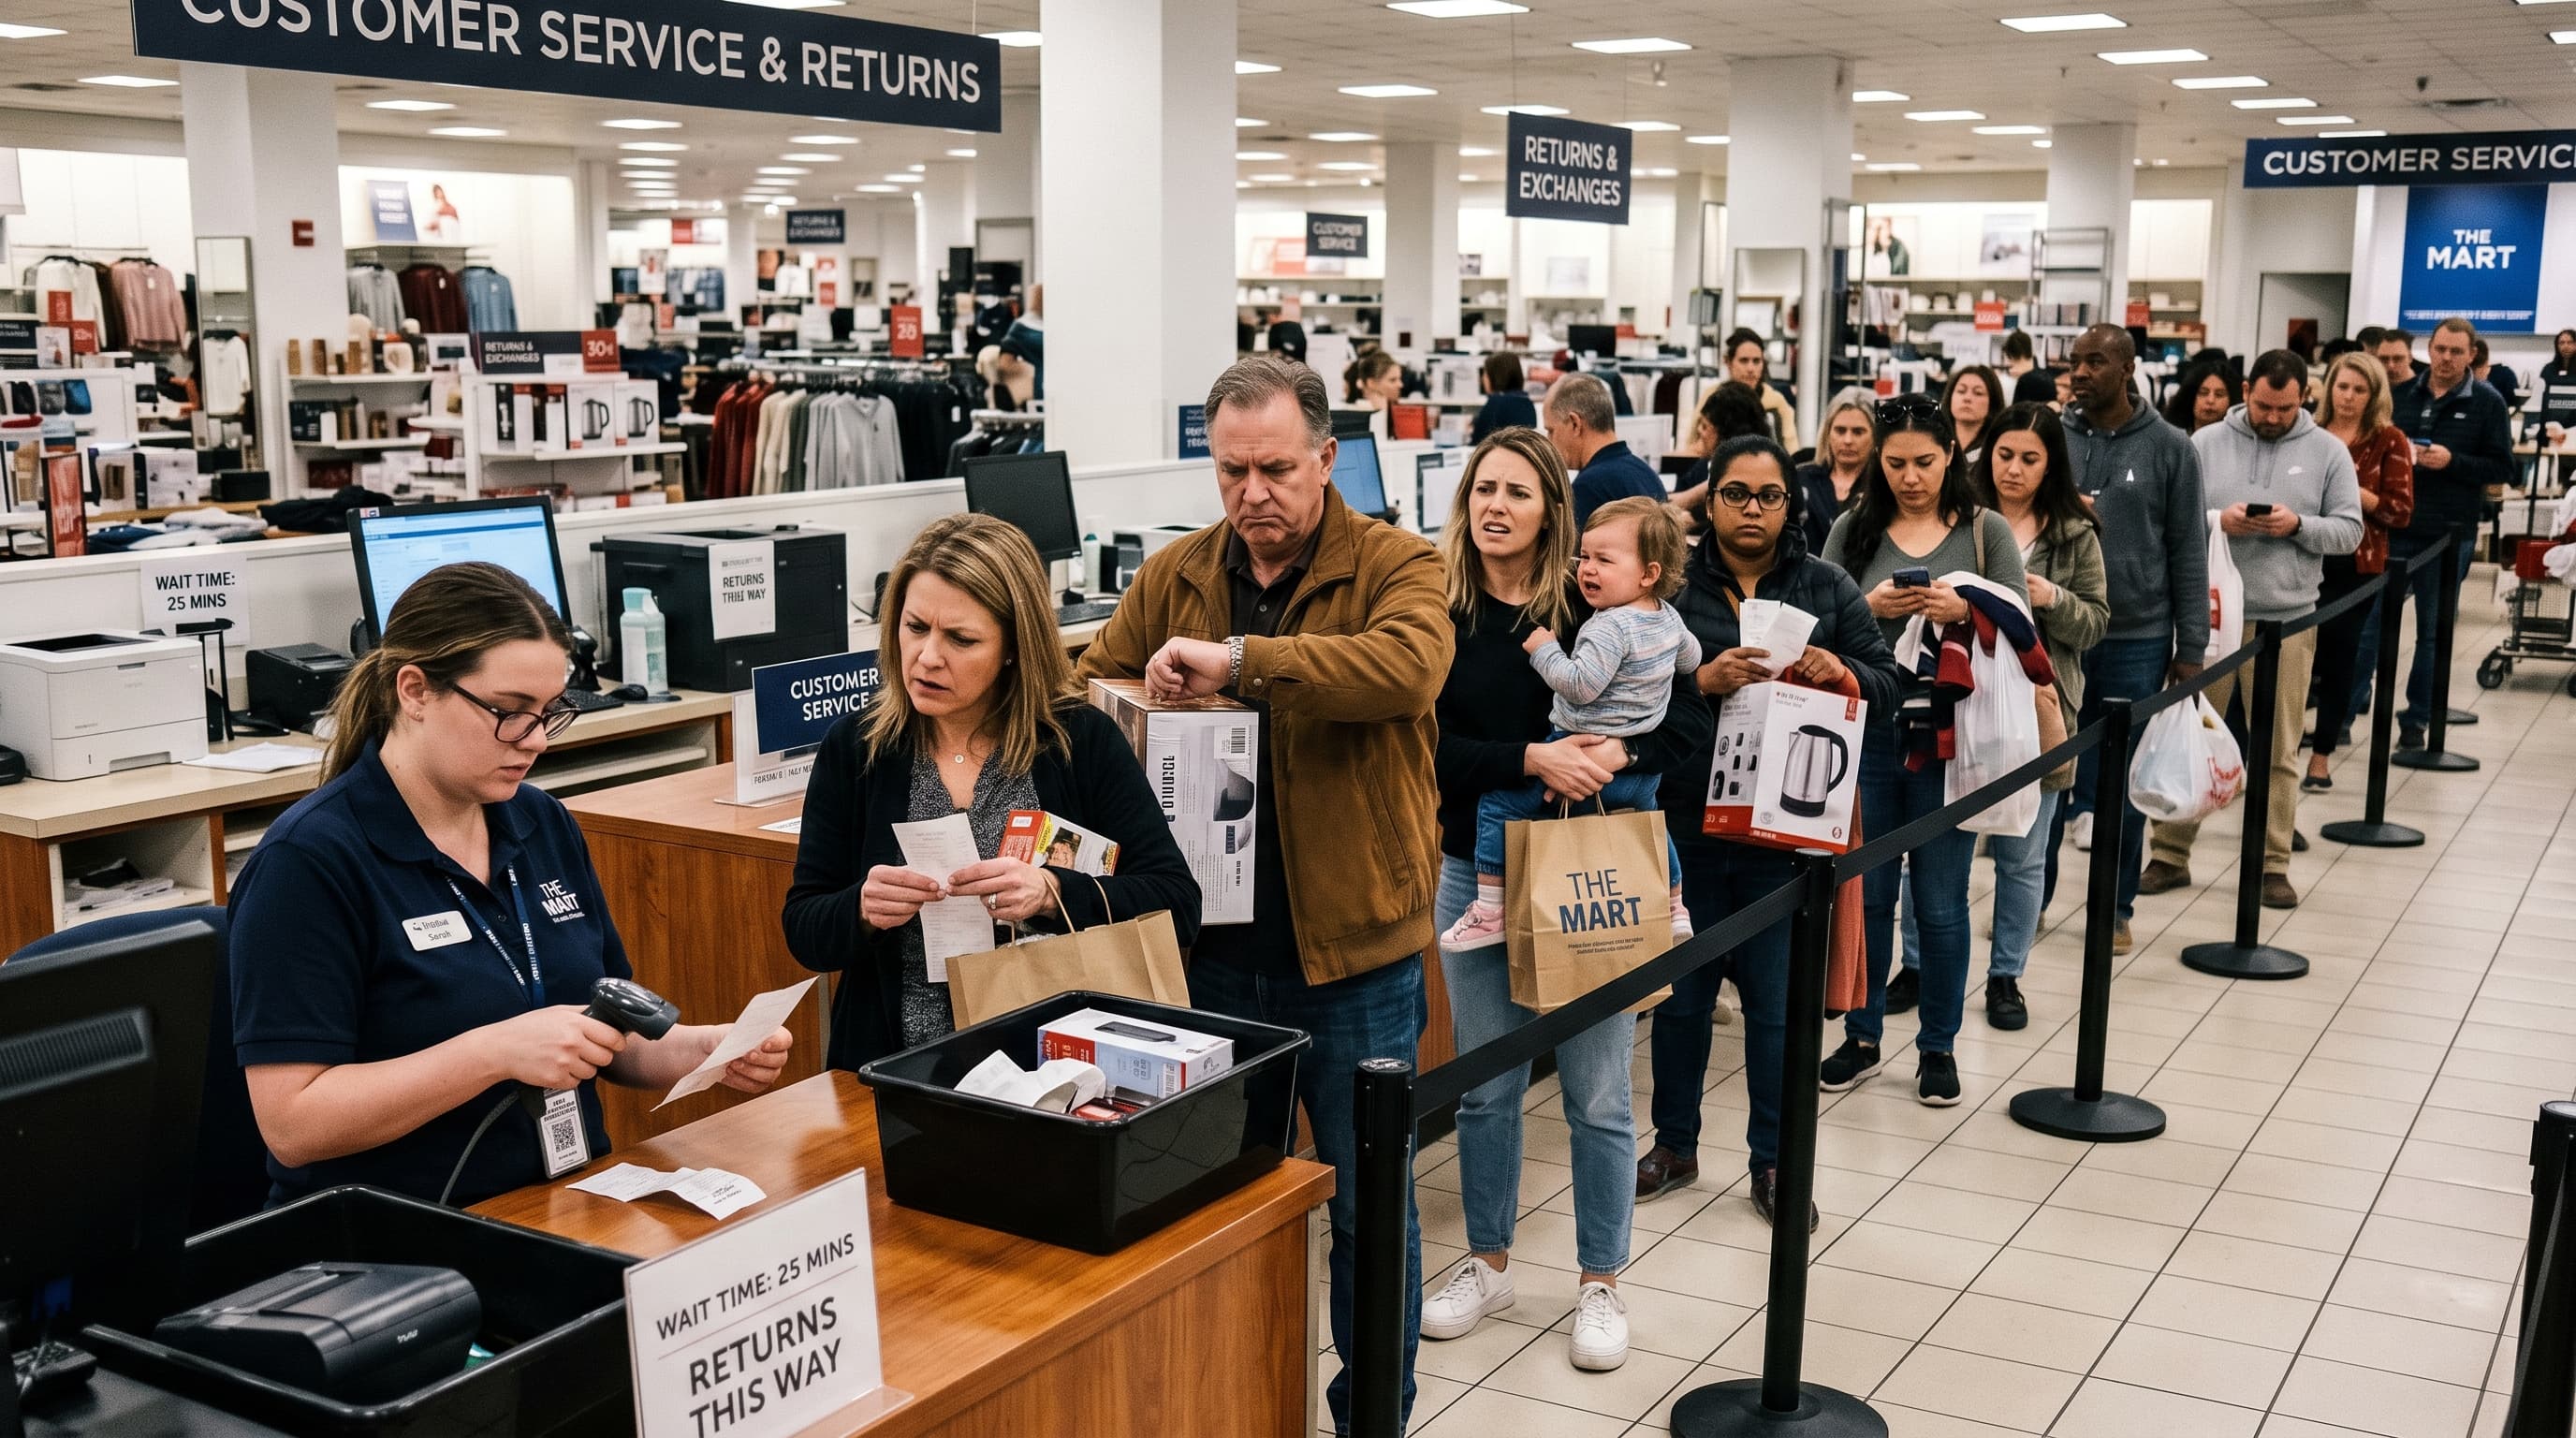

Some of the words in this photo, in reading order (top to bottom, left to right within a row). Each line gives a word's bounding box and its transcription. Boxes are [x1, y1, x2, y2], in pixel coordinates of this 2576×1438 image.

[540, 9, 746, 79] SERVICE
[759, 37, 788, 83] &
[802, 41, 981, 104] RETURNS
[1525, 135, 1603, 170] RETURNS
[1605, 144, 1618, 171] &
[2262, 147, 2440, 176] CUSTOMER
[2451, 143, 2576, 171] SERVIC
[1519, 170, 1621, 206] EXCHANGES
[2452, 229, 2493, 244] THE
[2426, 245, 2517, 270] MART
[155, 574, 192, 591] WAIT
[196, 571, 236, 588] TIME:
[723, 573, 765, 589] RETURNS
[747, 588, 767, 601] WAY
[168, 595, 186, 611] 25
[190, 593, 227, 609] MINS
[790, 668, 880, 699] CUSTOMER
[802, 691, 870, 722] SERVICE
[538, 879, 567, 899] THE
[1566, 869, 1622, 900] THE
[1559, 896, 1641, 934] MART
[656, 1298, 710, 1341] WAIT
[716, 1272, 773, 1313] TIME:
[778, 1256, 801, 1287] 25
[807, 1232, 856, 1273] MINS
[689, 1296, 838, 1397] RETURNS
[689, 1376, 766, 1438] THIS
[773, 1337, 842, 1399] WAY
